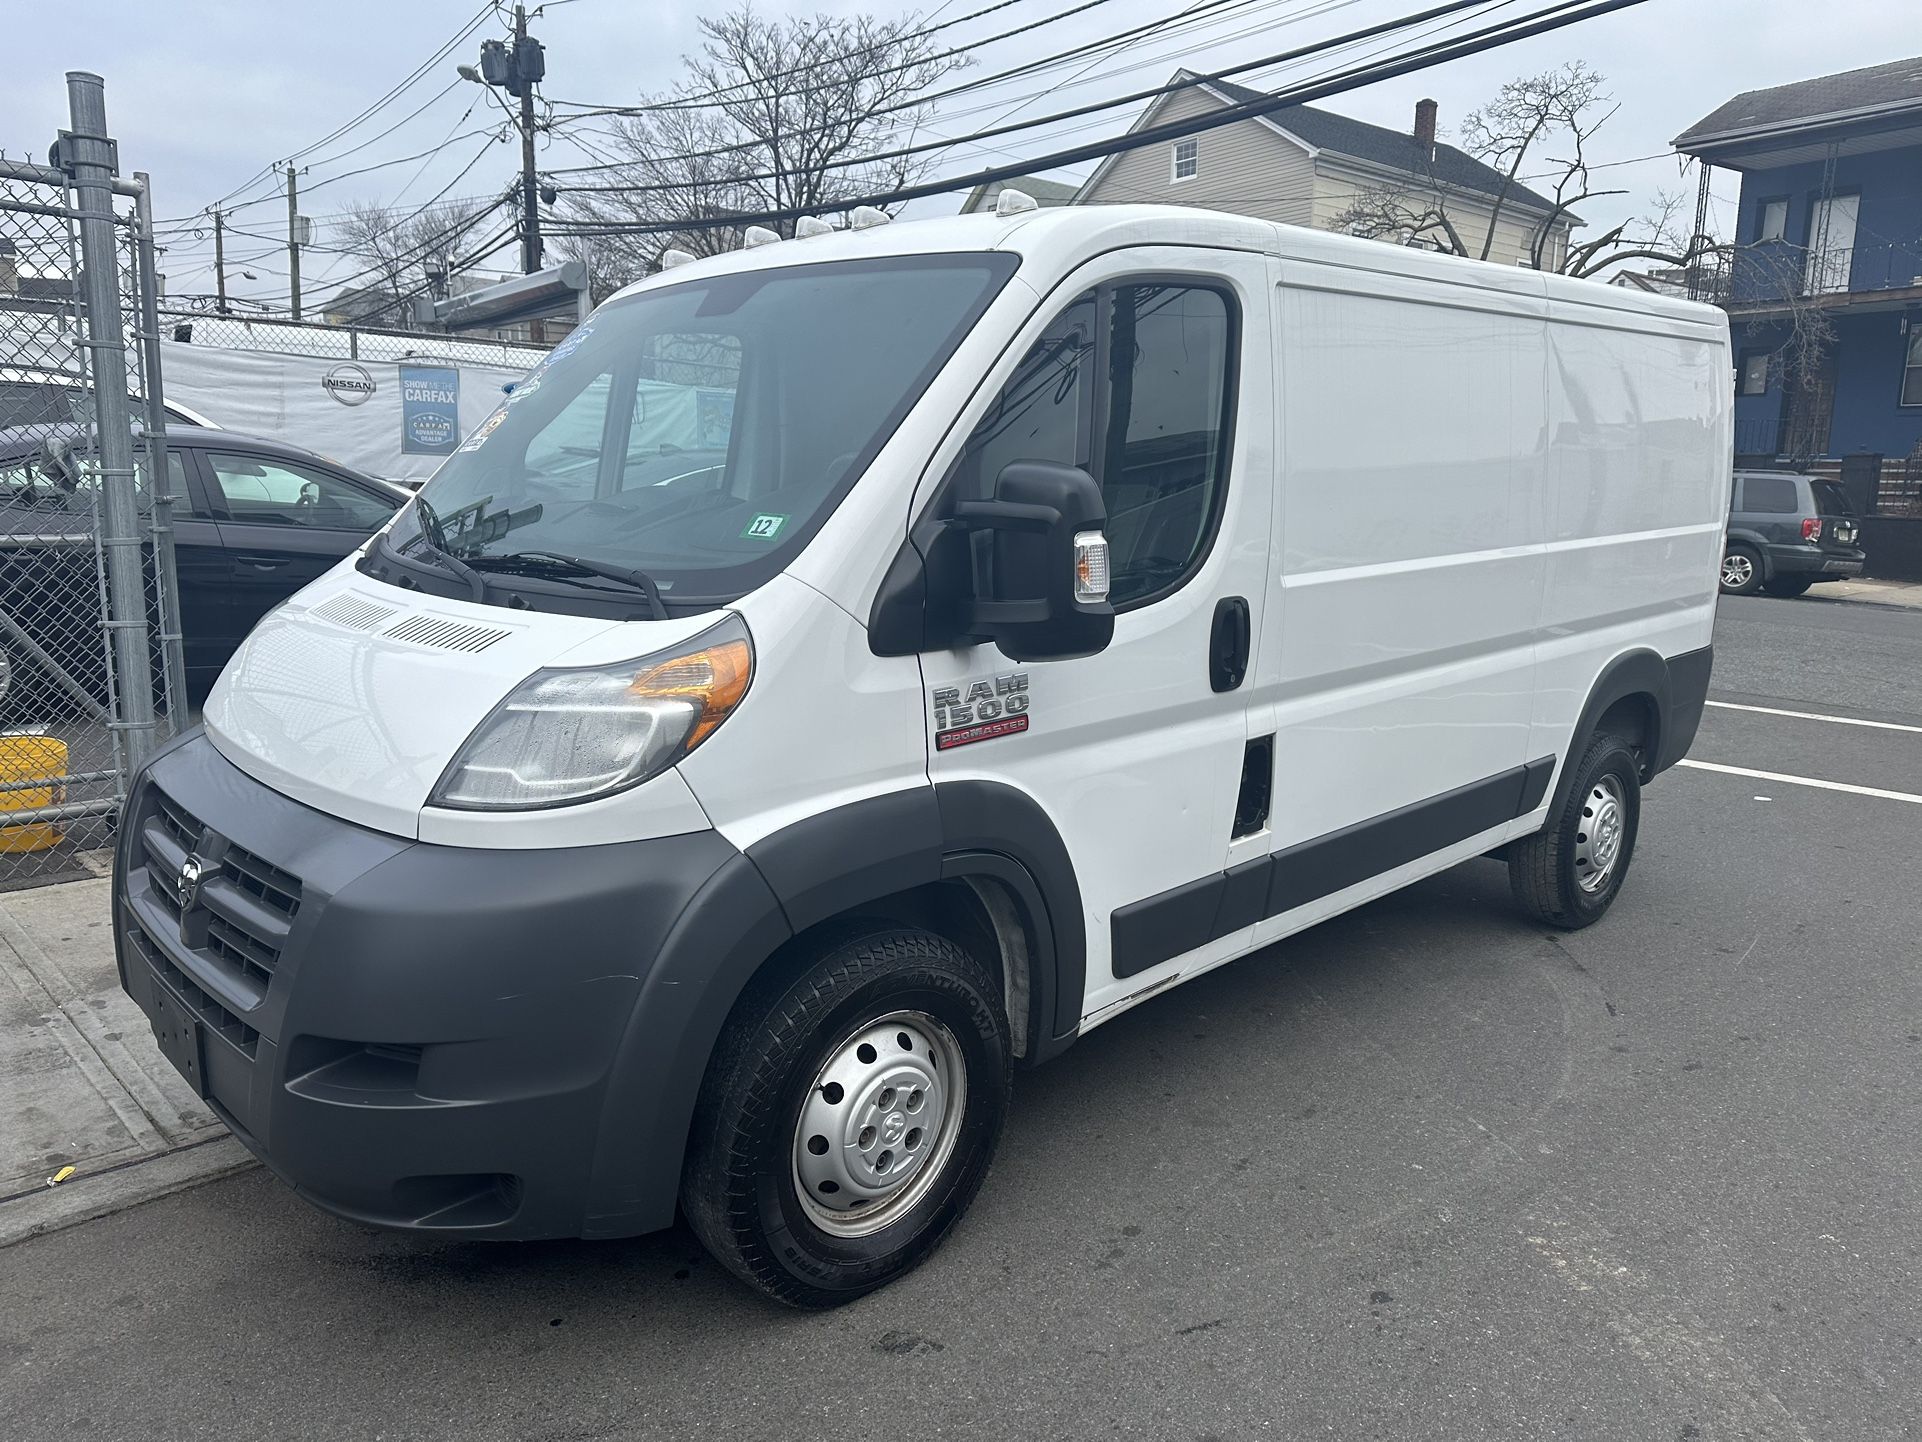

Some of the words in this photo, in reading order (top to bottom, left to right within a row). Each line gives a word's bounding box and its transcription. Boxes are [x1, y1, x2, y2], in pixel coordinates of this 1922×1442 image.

[327, 379, 371, 390] NISSAN
[404, 380, 428, 389] SHOW
[429, 381, 441, 390] ME
[442, 382, 455, 391] THE
[405, 389, 455, 403] CARFAX
[415, 429, 447, 437] ADVANTAGE
[750, 519, 773, 534] 12
[933, 672, 1029, 709] RAM
[934, 693, 1029, 730] 1500
